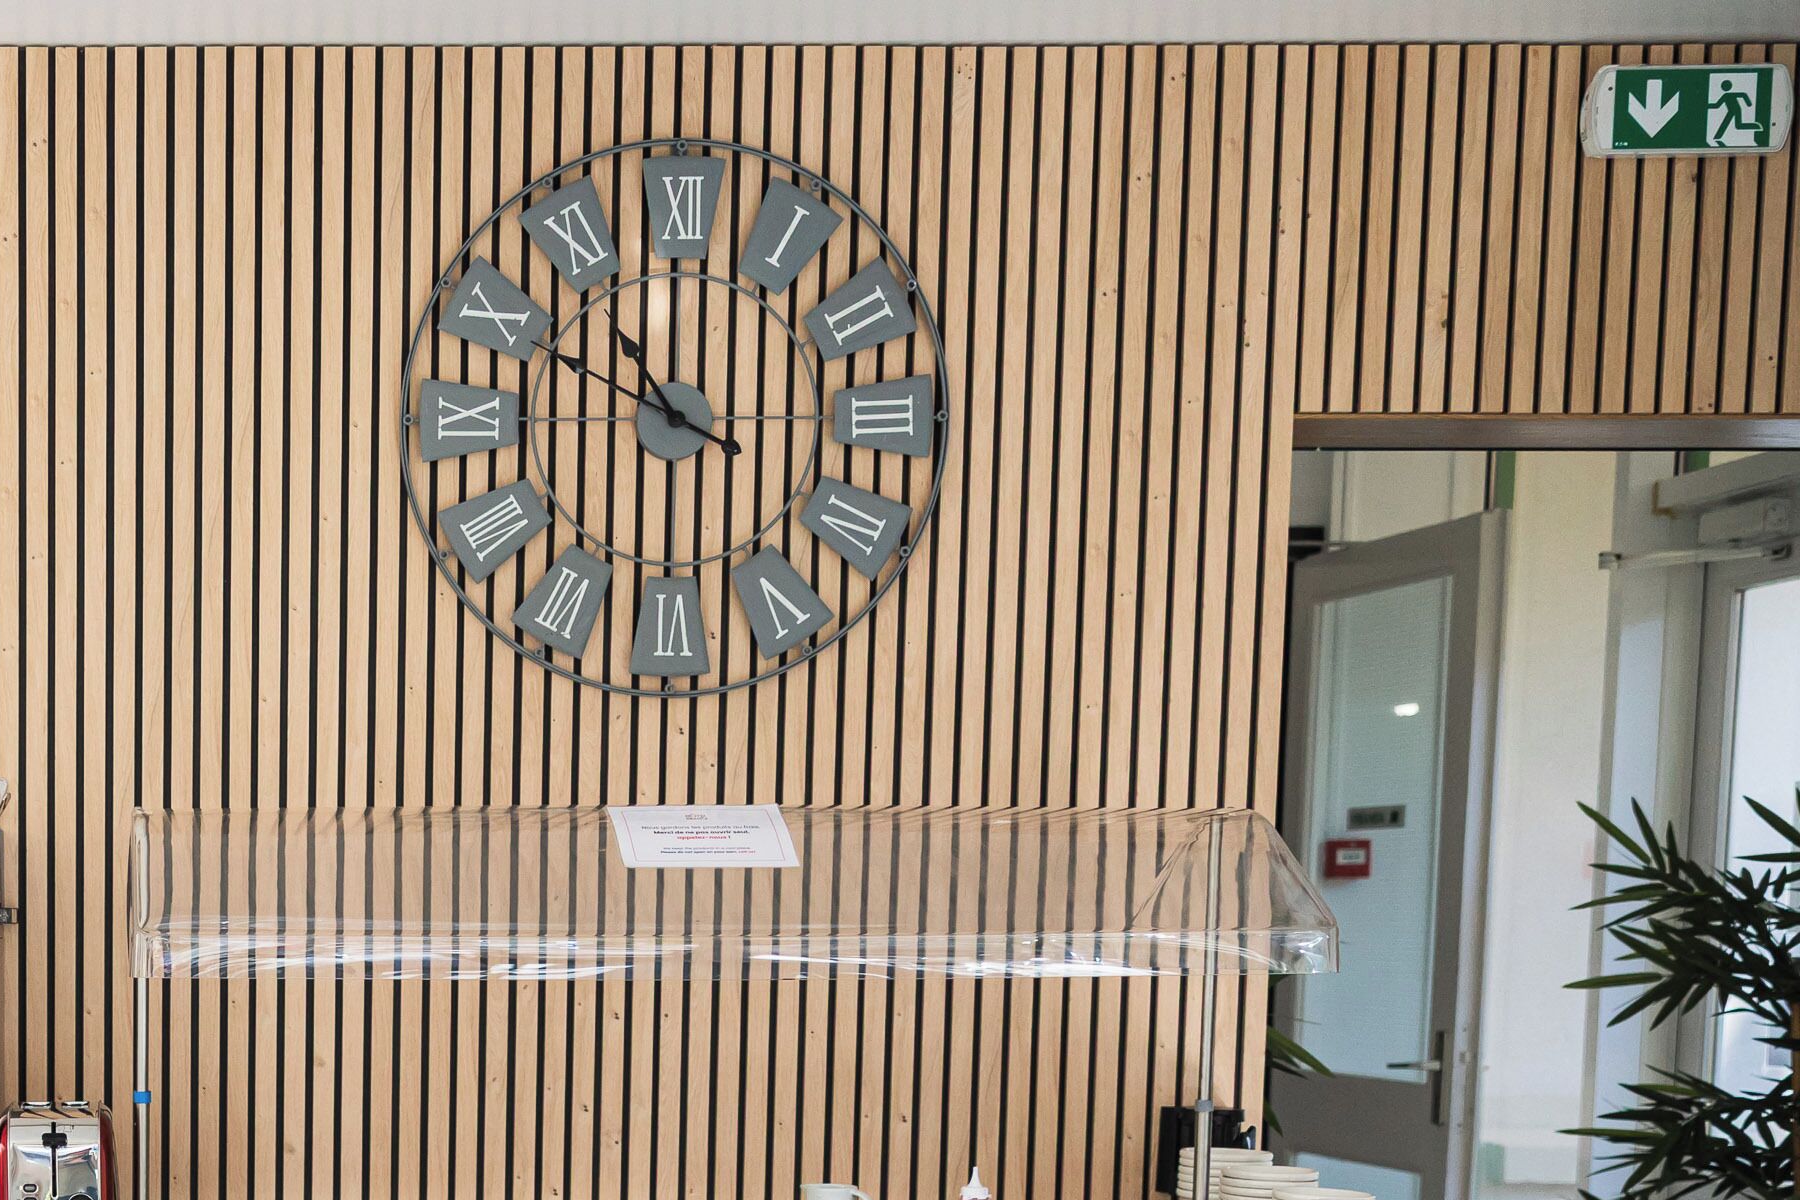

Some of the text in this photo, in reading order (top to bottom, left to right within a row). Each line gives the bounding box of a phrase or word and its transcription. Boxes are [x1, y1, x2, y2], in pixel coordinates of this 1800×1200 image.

[543, 200, 609, 276] XI
[662, 175, 704, 241] XII
[764, 205, 810, 269] I
[459, 281, 531, 347] X
[824, 285, 895, 347] II
[437, 397, 500, 440] IX
[851, 394, 915, 439] III
[459, 493, 529, 563] VIII
[820, 493, 887, 556] IV
[534, 566, 590, 640] VII
[653, 594, 693, 657] VI
[759, 577, 811, 640] V
